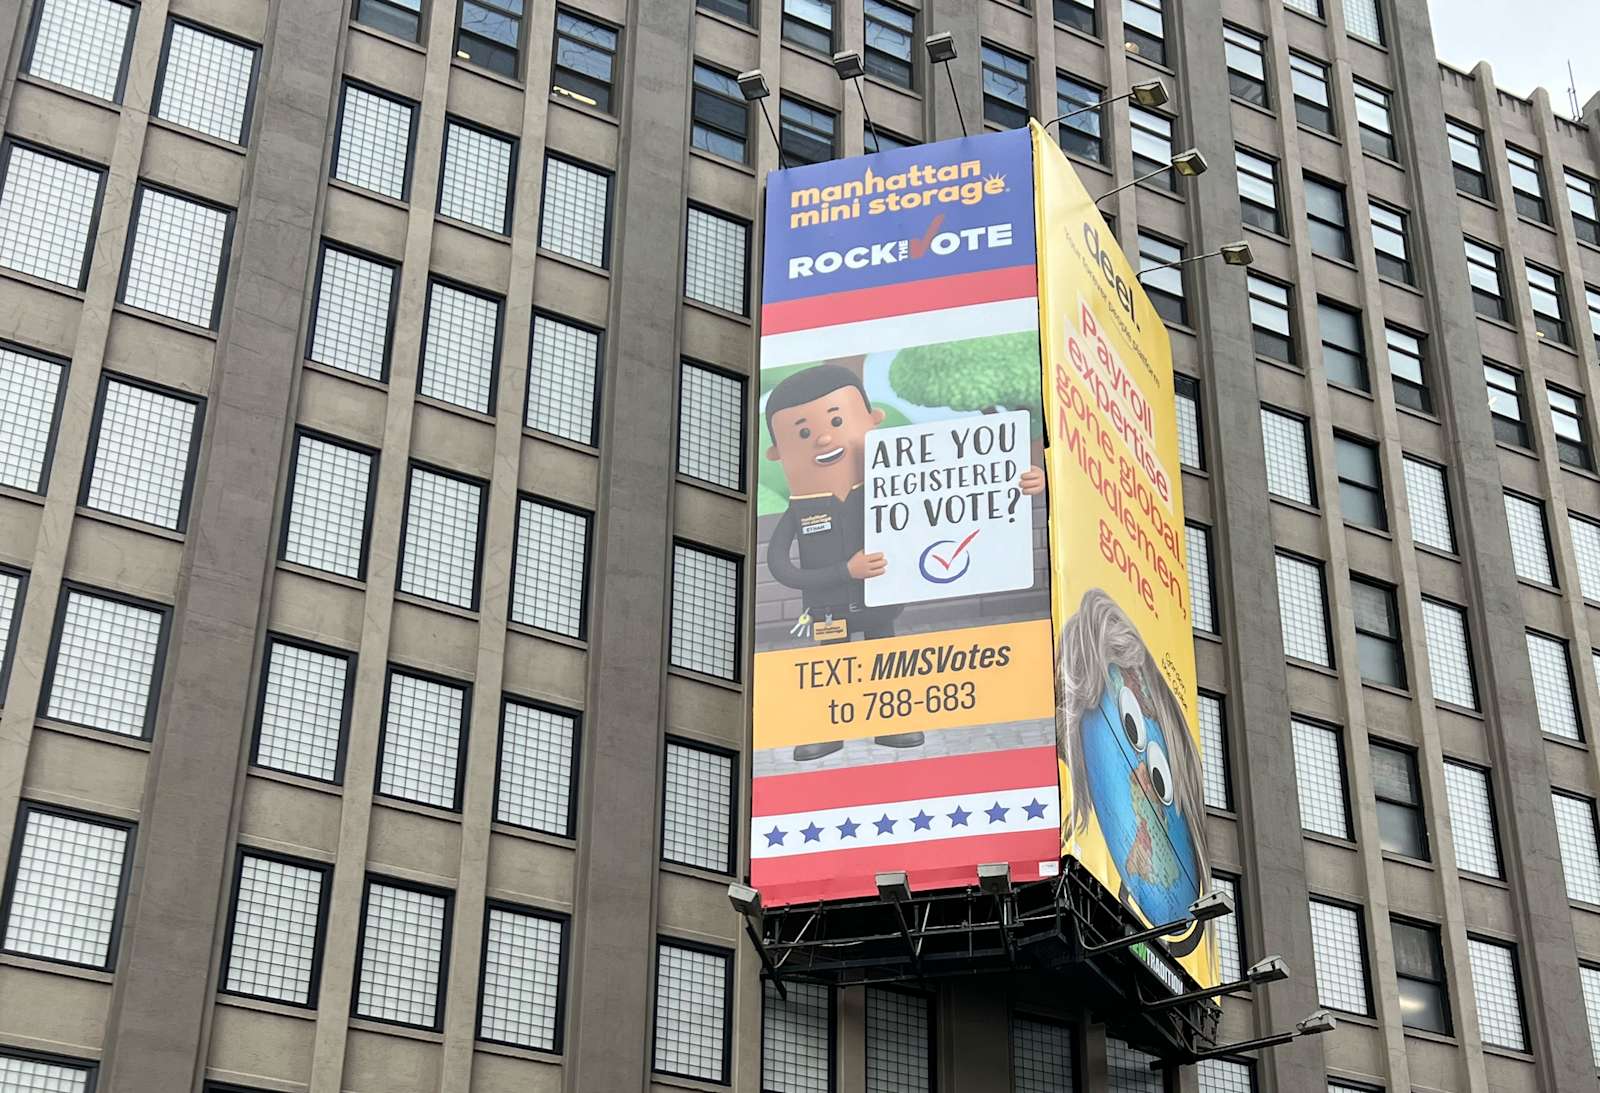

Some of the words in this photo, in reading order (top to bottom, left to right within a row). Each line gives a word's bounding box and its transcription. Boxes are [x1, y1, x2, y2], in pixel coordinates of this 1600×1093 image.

[790, 159, 981, 209] manhattan
[790, 199, 860, 229] mini
[868, 173, 1006, 215] storage
[788, 240, 900, 280] ROCK
[1081, 302, 1153, 439] Payroll
[1068, 336, 1169, 502] expertise
[871, 433, 936, 470] ARE
[951, 422, 1016, 460] YOU
[1056, 363, 1116, 465] gone
[1119, 455, 1185, 571] global.
[873, 459, 1017, 499] REGISTERED
[870, 502, 910, 534] TO
[923, 487, 1021, 528] VOTE?
[1098, 518, 1159, 621] gone.
[795, 656, 863, 690] TEXT:
[870, 643, 1012, 682] MMSVotes
[828, 699, 855, 725] to
[863, 681, 977, 721] 788-683
